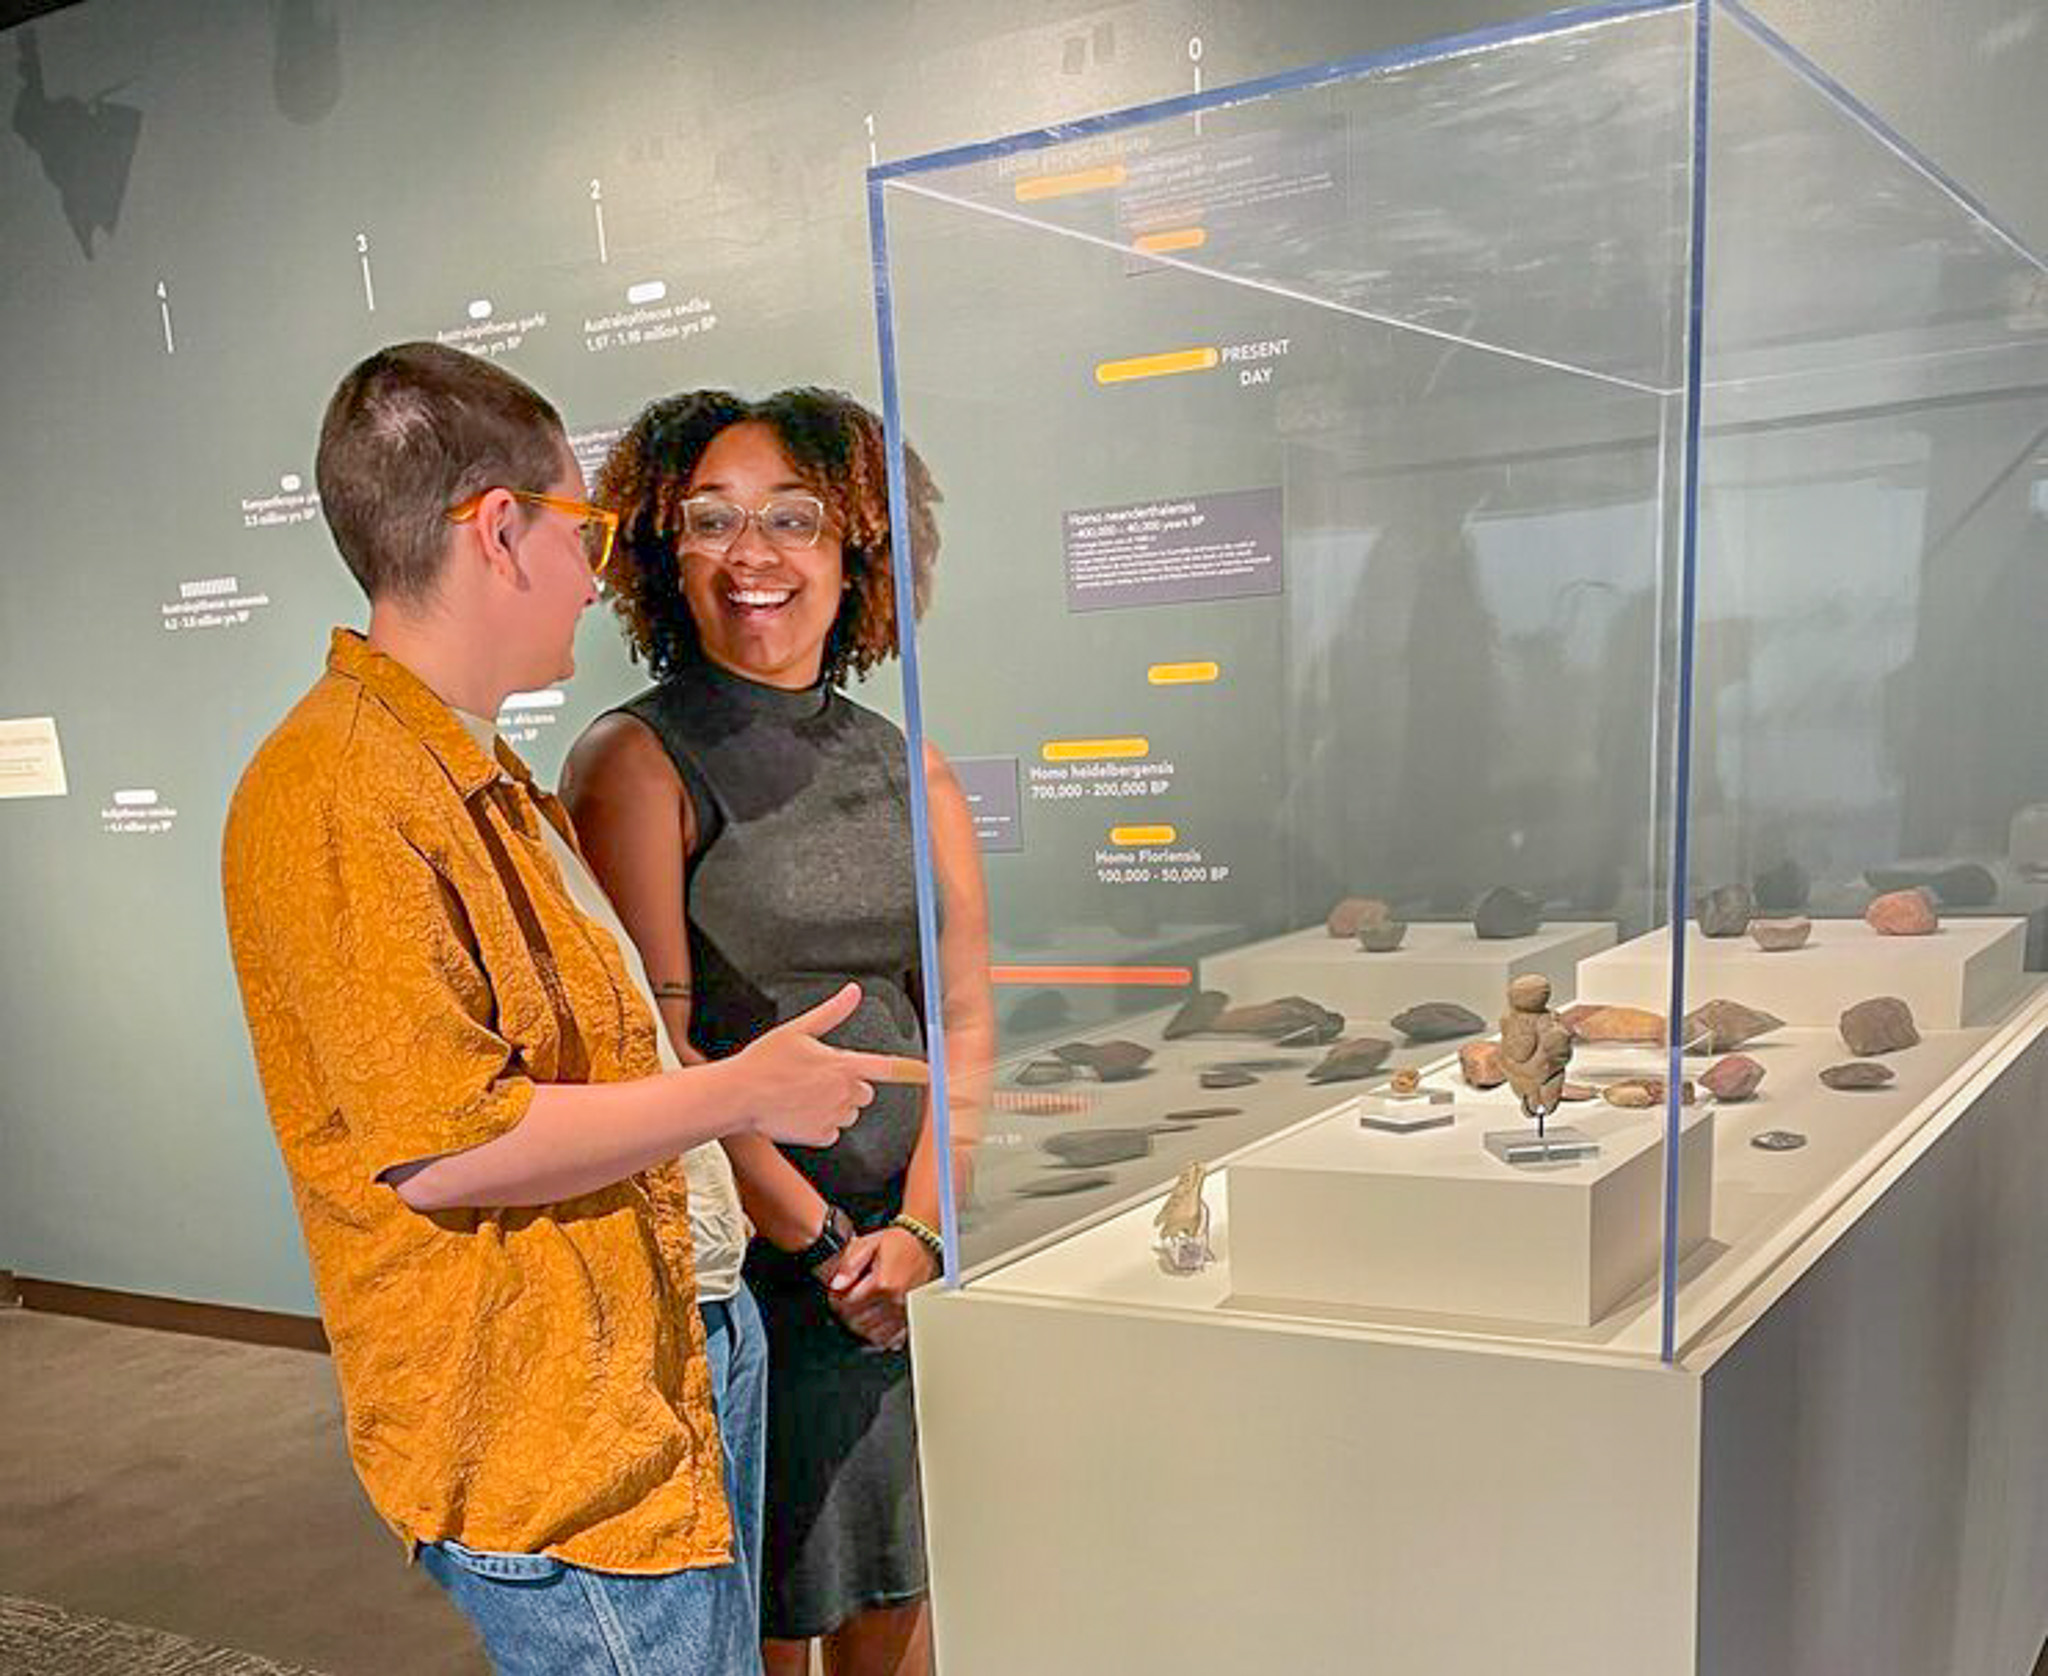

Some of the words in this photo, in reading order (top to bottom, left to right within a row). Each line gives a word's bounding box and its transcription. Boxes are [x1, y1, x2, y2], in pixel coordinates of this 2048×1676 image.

[1188, 38, 1203, 60] 0
[864, 115, 874, 136] 1
[589, 179, 602, 200] 2
[355, 234, 368, 253] 3
[156, 280, 167, 299] 4
[1221, 339, 1290, 363] PRESENT
[1240, 367, 1273, 385] DAY
[1068, 511, 1101, 526] Homo
[1030, 767, 1069, 780] Homo
[1070, 762, 1174, 780] heidelbergensis
[1030, 783, 1083, 800] 700,000
[1093, 780, 1147, 798] 200,000
[1149, 779, 1169, 794] BP
[1095, 850, 1135, 864] Homo
[1138, 847, 1202, 862] Floriensis
[1097, 868, 1150, 884] 100,000
[1161, 865, 1207, 884] 50,000
[1209, 865, 1230, 881] BP
